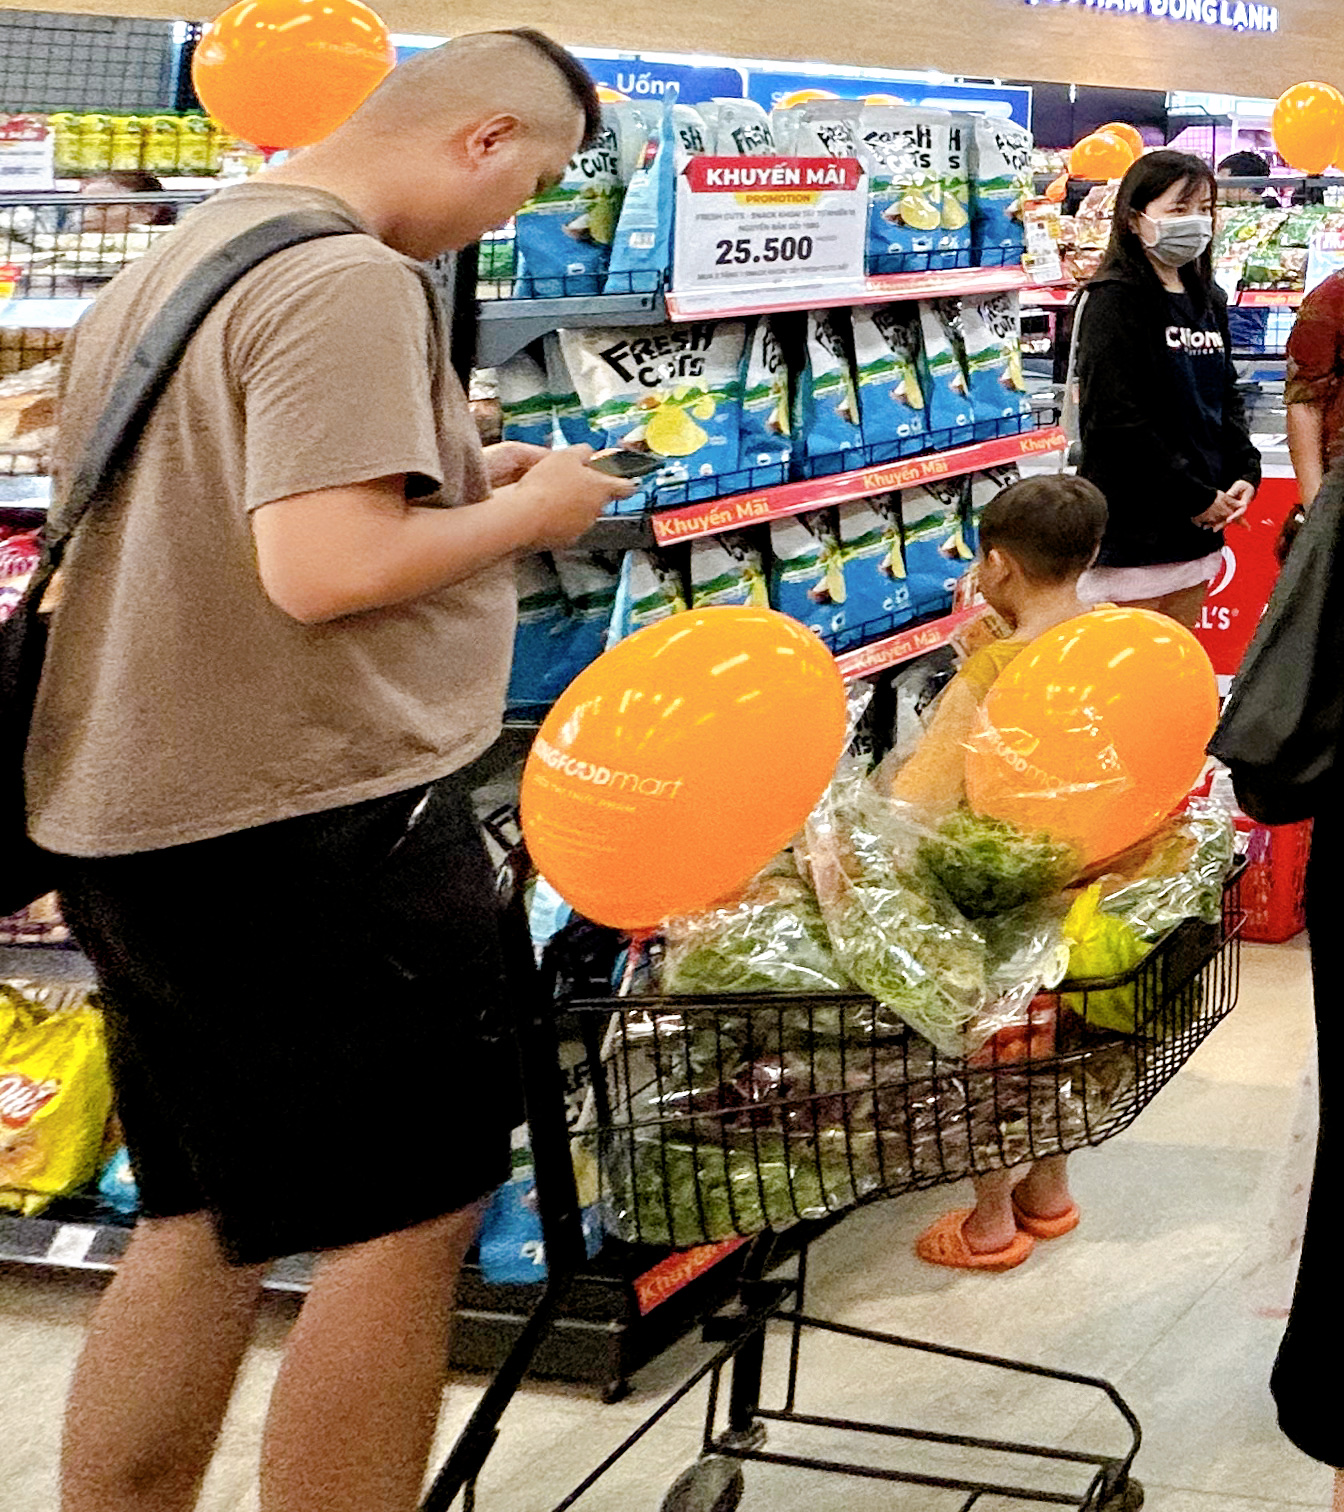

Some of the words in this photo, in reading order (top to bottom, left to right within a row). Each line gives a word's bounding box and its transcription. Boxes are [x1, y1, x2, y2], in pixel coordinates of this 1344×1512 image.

[1219, 0, 1279, 32] LẠNH
[616, 72, 680, 95] Uống
[706, 162, 800, 186] KHUYẾN
[806, 164, 846, 185] MÃI
[745, 193, 811, 204] PROMOTION
[715, 236, 813, 266] 25.500
[599, 324, 718, 383] FRESH
[638, 353, 706, 388] CUTS
[863, 466, 920, 490] Khuyến
[921, 457, 948, 475] Mãi
[657, 504, 733, 538] Khuyến
[735, 497, 770, 519] Mãi
[1195, 606, 1230, 630] L'S
[857, 642, 912, 671] Khuyến
[913, 629, 941, 647] Mãi
